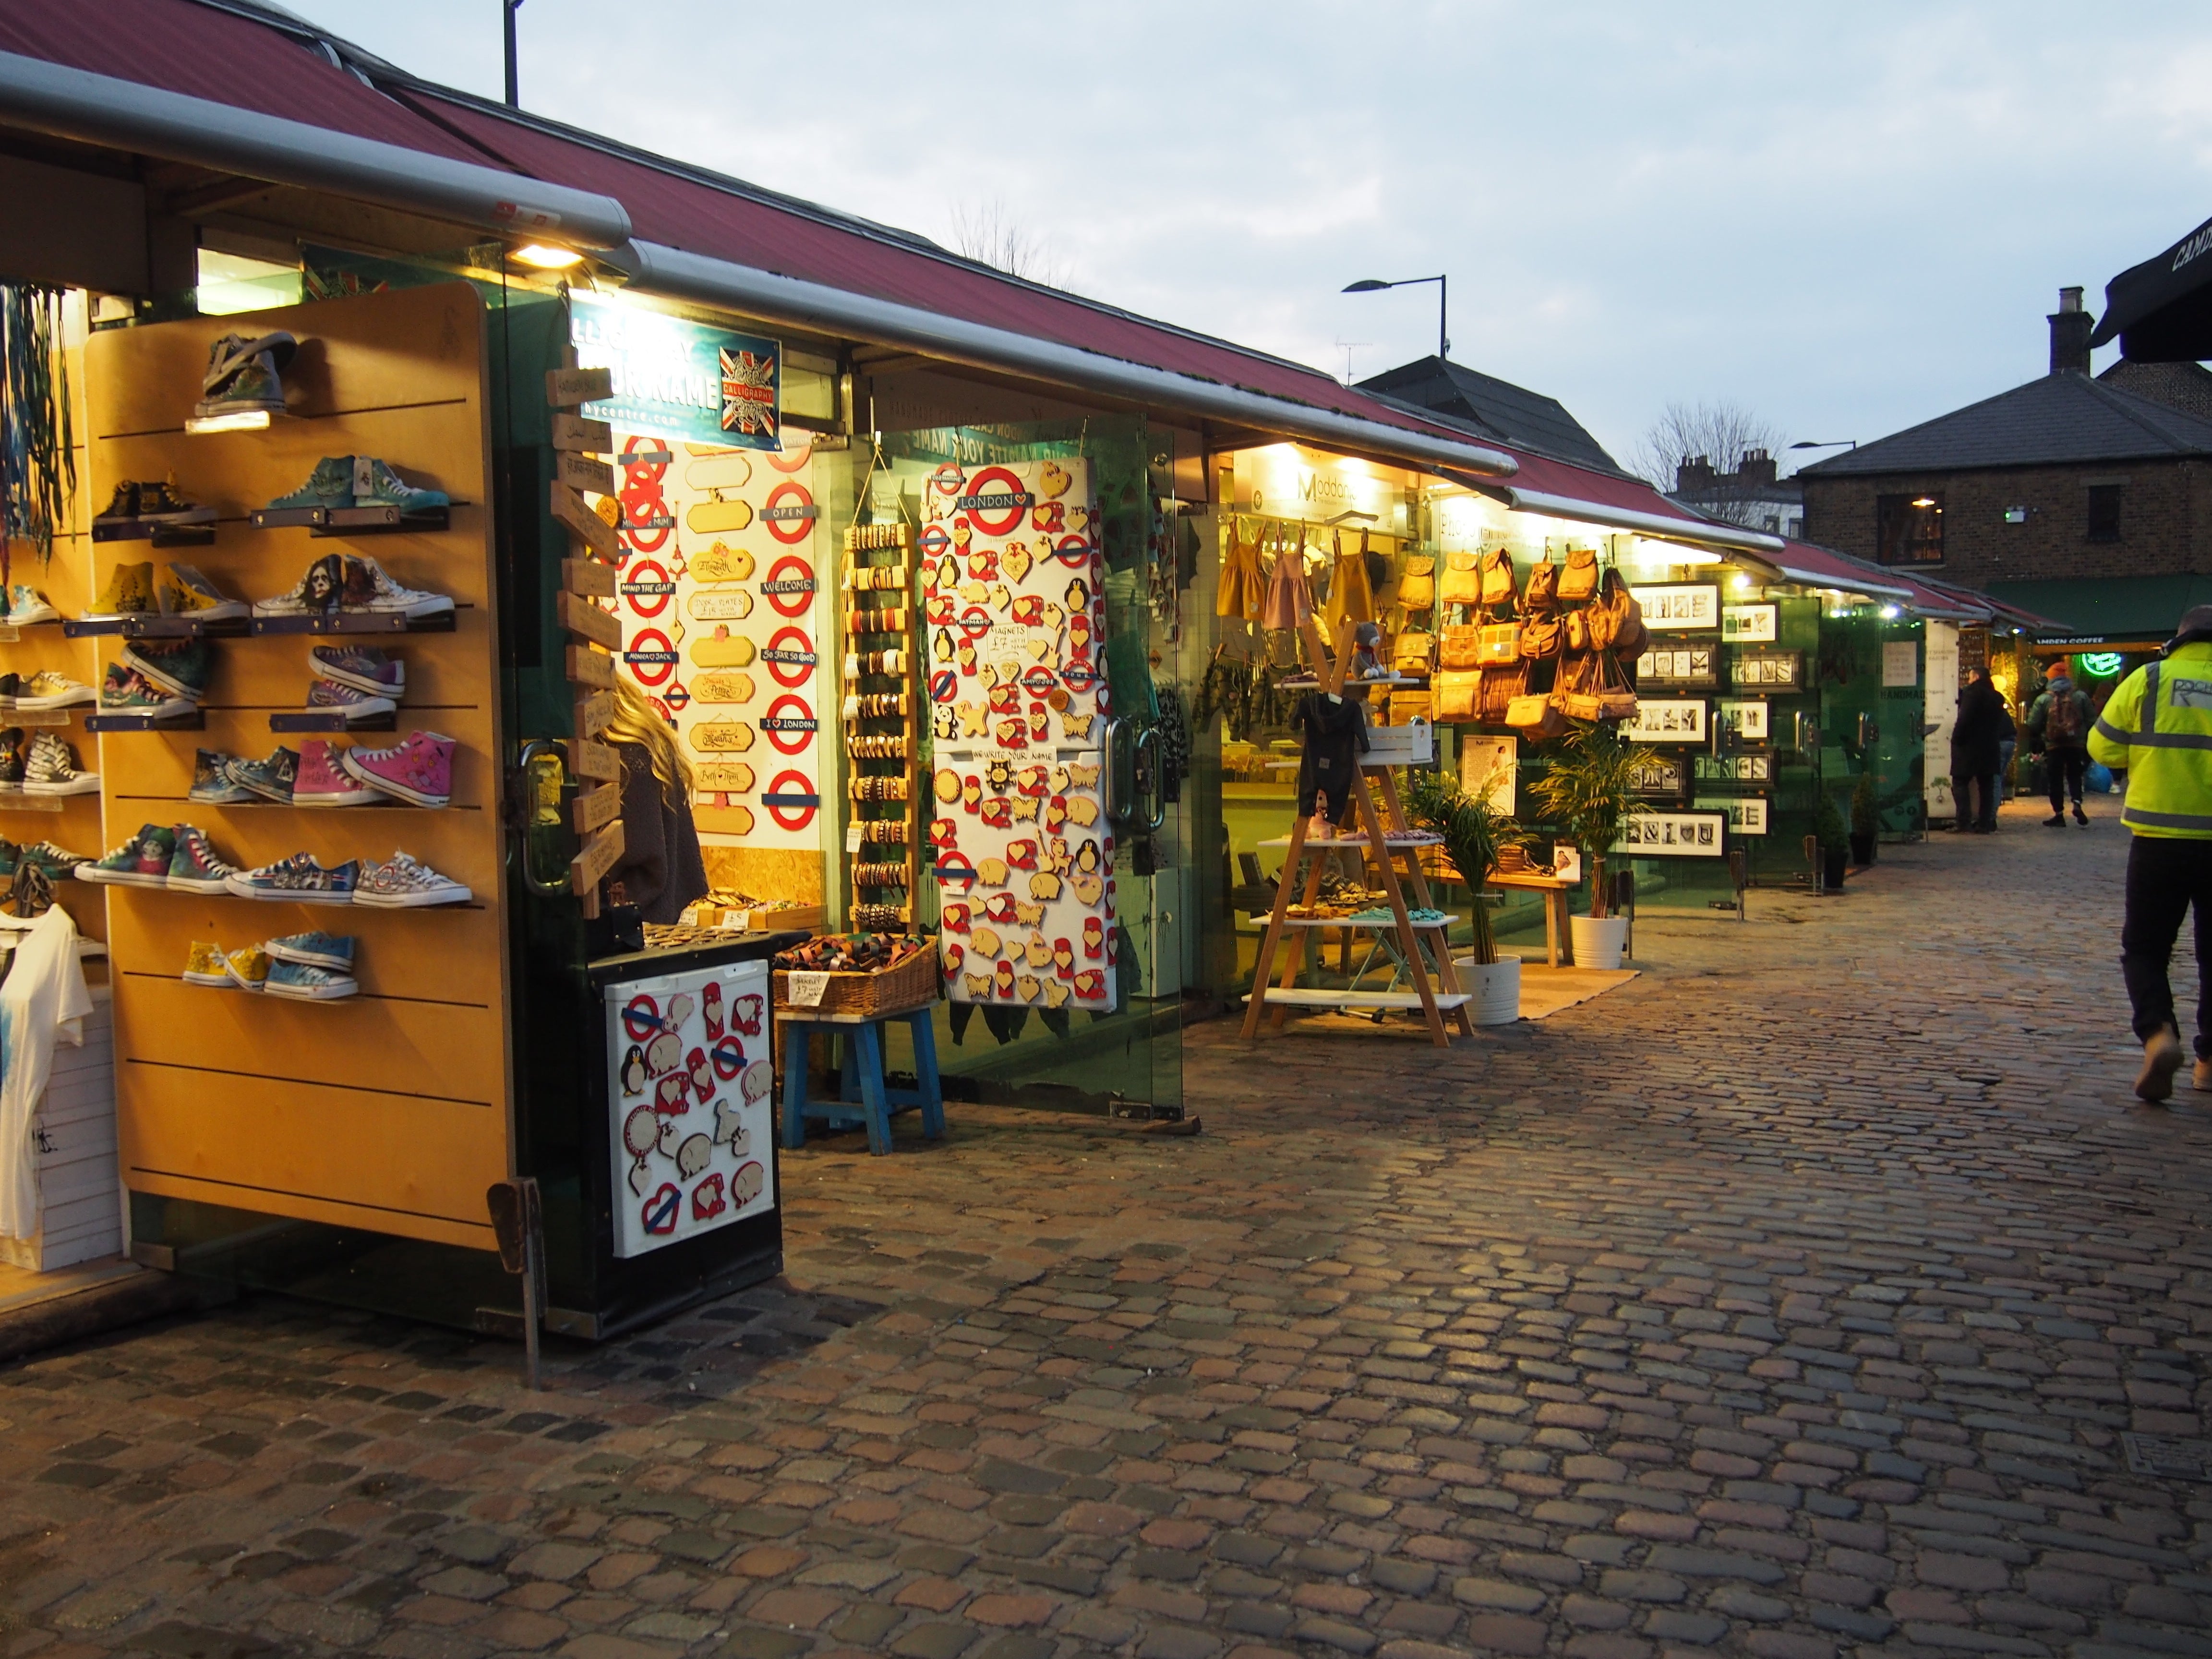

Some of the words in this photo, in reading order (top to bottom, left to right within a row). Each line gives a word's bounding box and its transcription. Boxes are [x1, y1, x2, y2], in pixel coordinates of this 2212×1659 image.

[651, 372, 719, 409] NAME
[723, 383, 772, 400] CALLIGRAPHY
[962, 495, 1013, 509] LONDON
[773, 507, 802, 517] OPEN
[654, 517, 669, 526] MUM
[622, 584, 640, 592] MIND
[641, 584, 654, 593] THE
[655, 583, 673, 592] GAP
[764, 579, 811, 592] WELCOME
[719, 598, 743, 606] PLATES
[990, 626, 1025, 635] MAGNETS
[990, 637, 1007, 651] £7
[656, 652, 672, 661] JACK
[799, 653, 815, 662] GOOD
[767, 719, 771, 728] I
[783, 720, 815, 729] LONDON
[984, 751, 1004, 759] WRITE
[1010, 751, 1027, 760] YOUR
[1032, 752, 1052, 761] NAME
